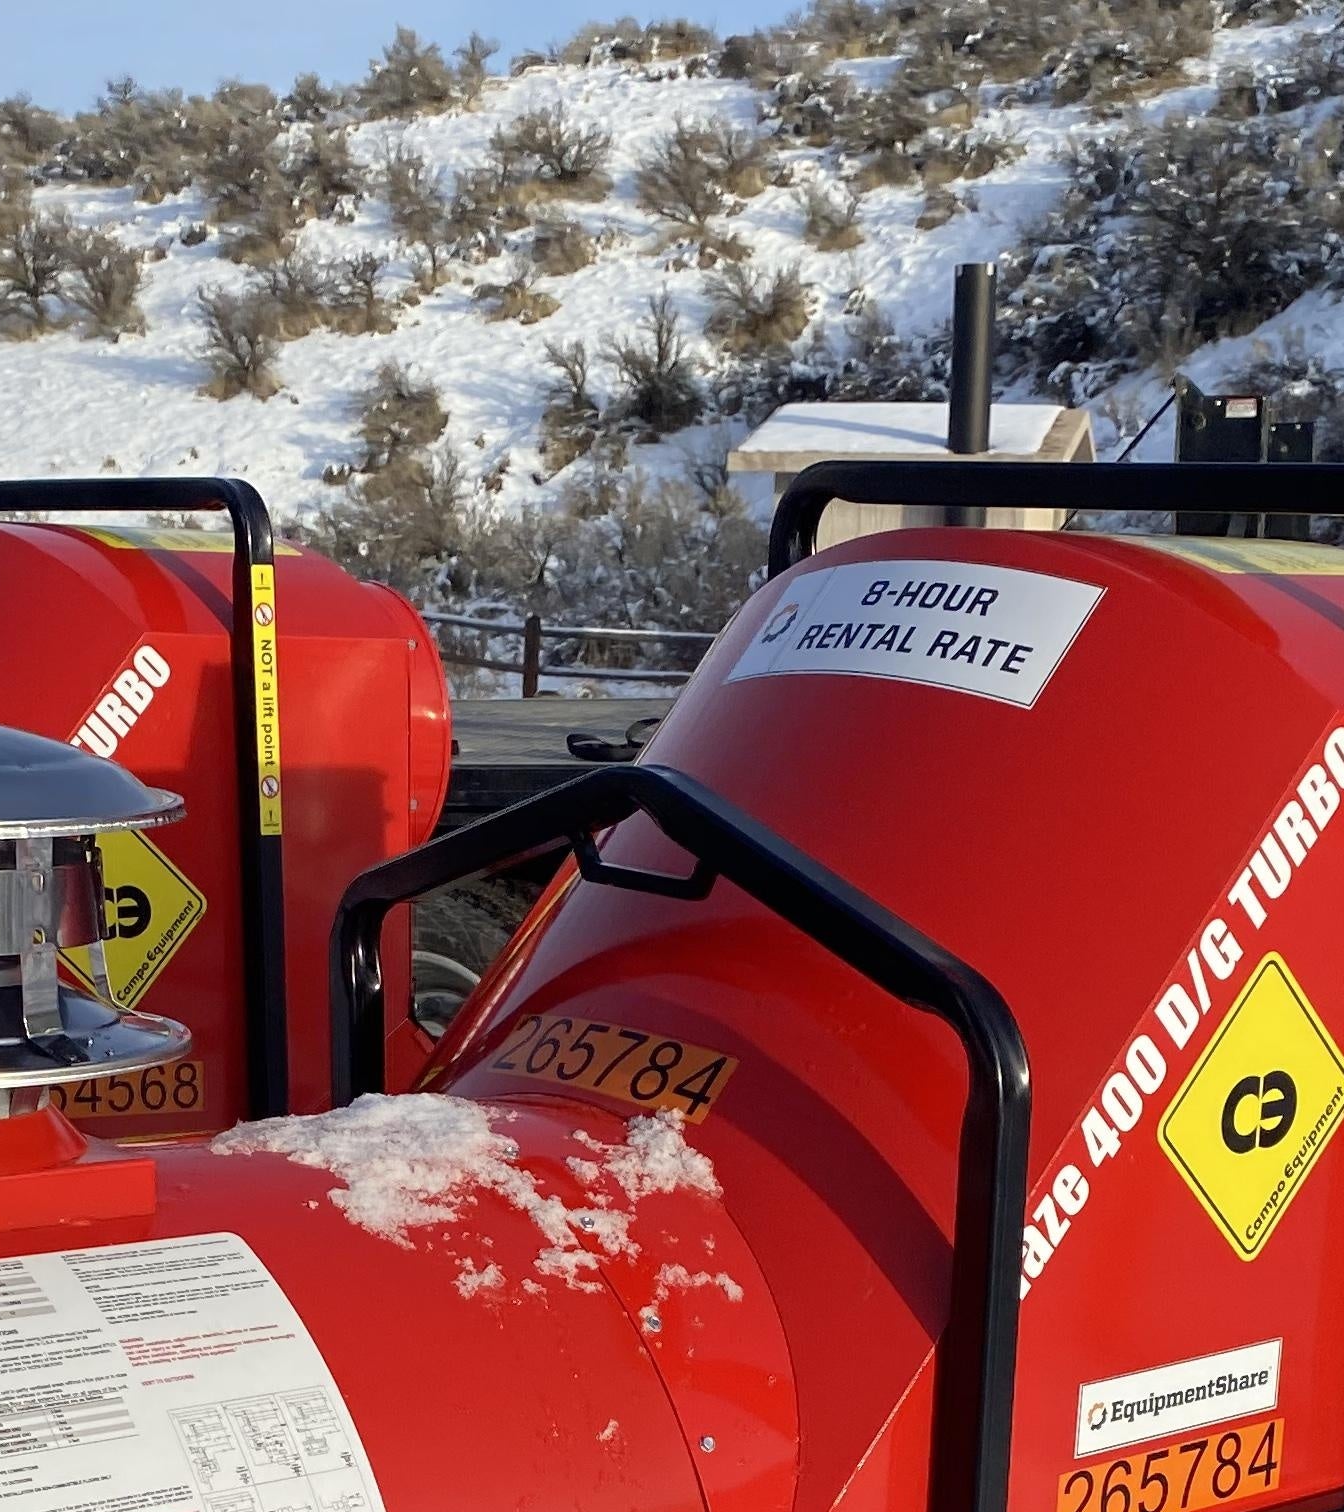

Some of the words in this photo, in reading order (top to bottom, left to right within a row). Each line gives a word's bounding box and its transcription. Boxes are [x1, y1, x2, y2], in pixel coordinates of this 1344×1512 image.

[860, 580, 1000, 617] 8-HOUR
[260, 639, 273, 677] NOT
[796, 623, 917, 654] RENTAL
[926, 630, 1034, 675] RATE
[262, 682, 271, 691] a
[262, 697, 274, 718] lift
[261, 724, 275, 767] point
[117, 961, 150, 1002] Campo
[146, 900, 195, 962] Equipment
[493, 1015, 728, 1116] 265784
[1020, 1164, 1090, 1301] aze
[1081, 1033, 1168, 1169] 400
[1153, 918, 1245, 1051] D/G
[1245, 1180, 1286, 1240] Campo
[1284, 1086, 1344, 1179] Equipment
[1110, 1369, 1269, 1423] EquipmentShare
